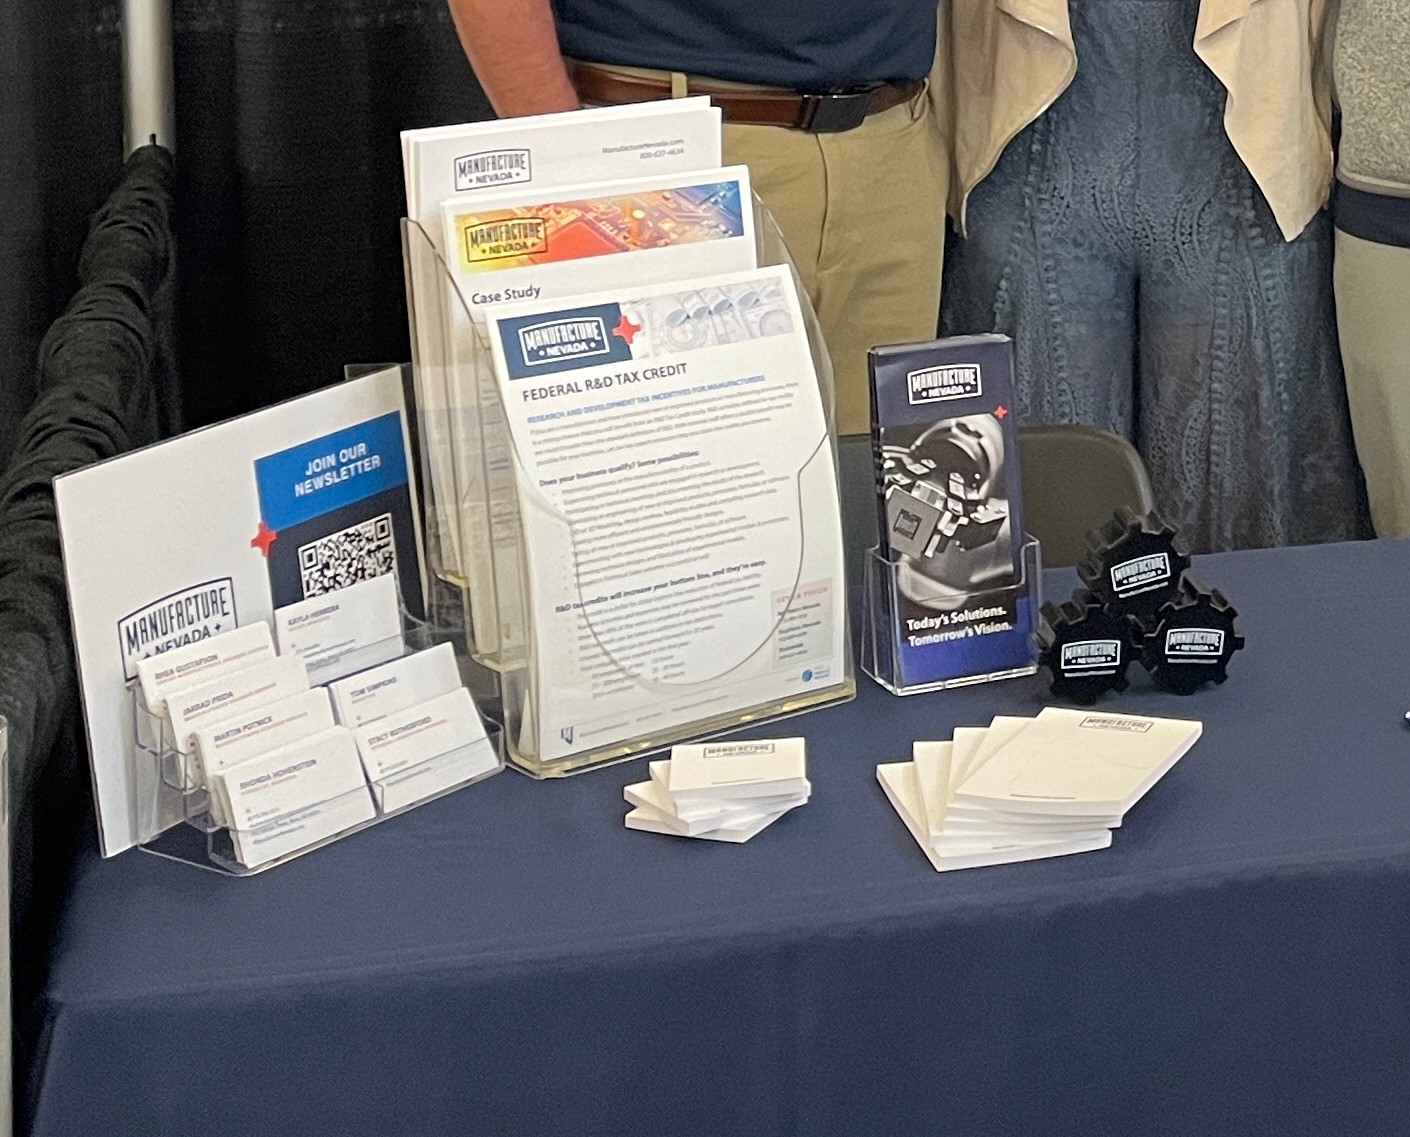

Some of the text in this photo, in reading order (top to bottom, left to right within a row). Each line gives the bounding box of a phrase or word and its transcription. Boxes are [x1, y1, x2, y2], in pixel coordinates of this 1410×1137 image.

[459, 152, 528, 179] MANUFACTURE
[475, 171, 514, 185] NEVADA
[469, 221, 542, 249] MANUFACTURE
[489, 241, 530, 255] NEVADA
[471, 284, 542, 305] Case Study
[523, 320, 602, 352] MANUFACTURE
[546, 341, 589, 357] NEVADA
[522, 362, 688, 403] FEDERAL R&D TAX CREDIT
[911, 368, 977, 392] MANUFACTURE
[305, 442, 368, 476] JOIN OUR
[294, 454, 383, 498] NEWSLETTER
[125, 585, 231, 656] MANUFACTURE
[906, 605, 1007, 632] Today's Solutions.
[907, 621, 1014, 648] Tomorrow's Vision.
